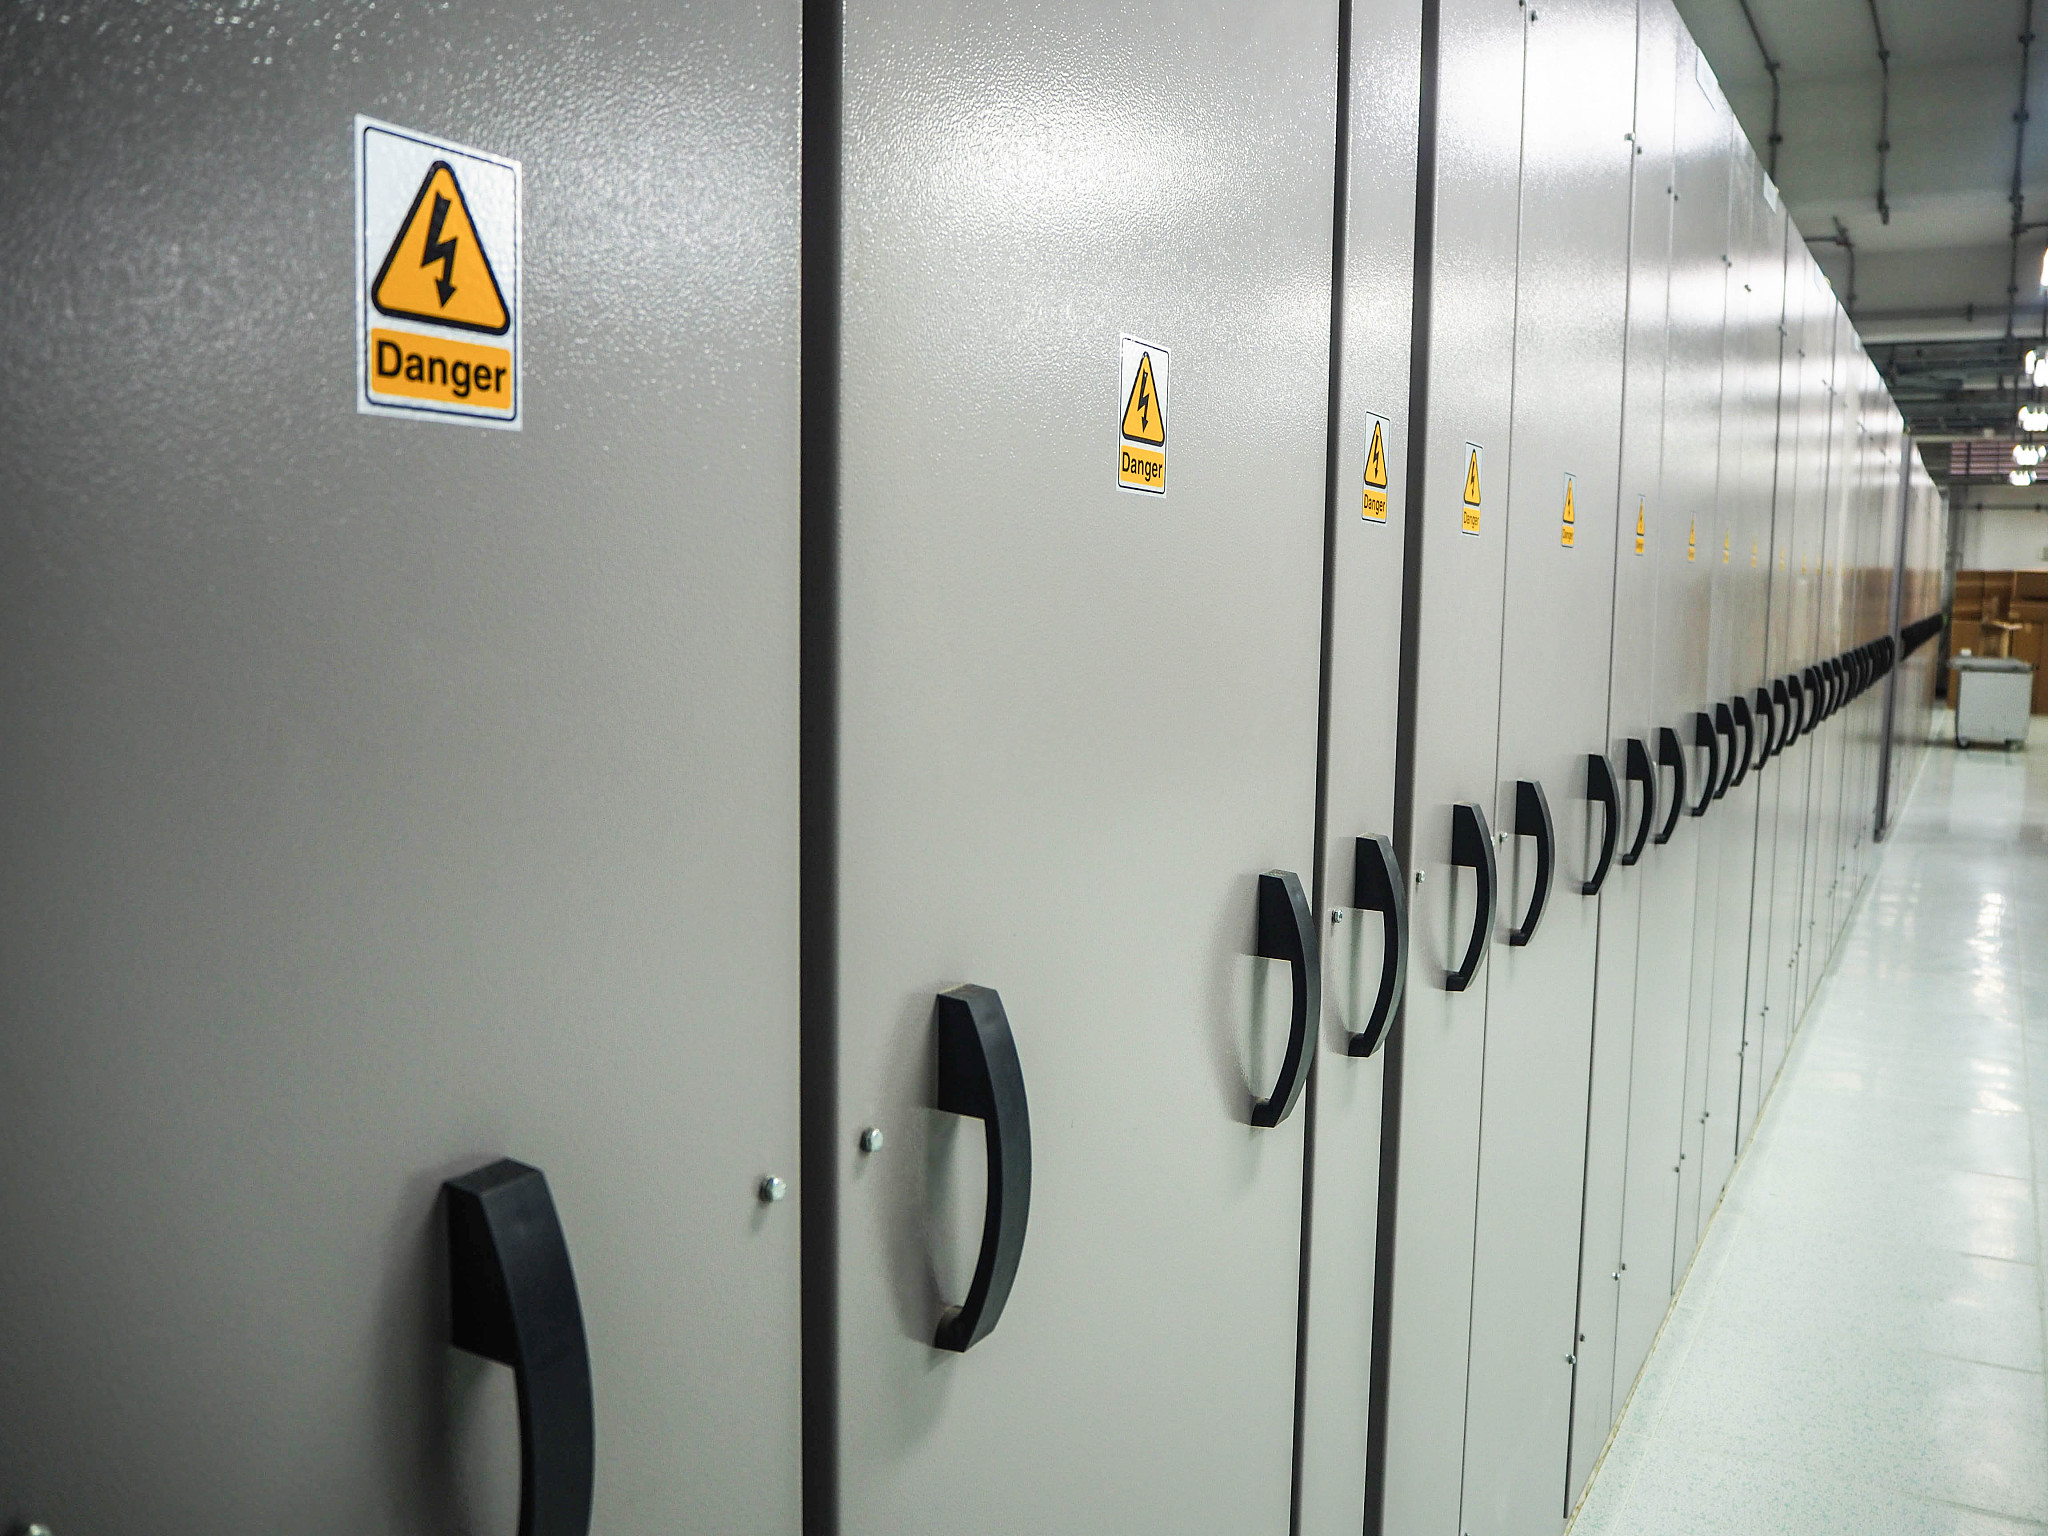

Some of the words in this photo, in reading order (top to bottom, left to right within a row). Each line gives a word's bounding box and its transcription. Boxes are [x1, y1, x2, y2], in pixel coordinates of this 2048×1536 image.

[377, 340, 507, 397] Danger
[1122, 451, 1163, 482] Danger
[1364, 493, 1385, 515] Danger
